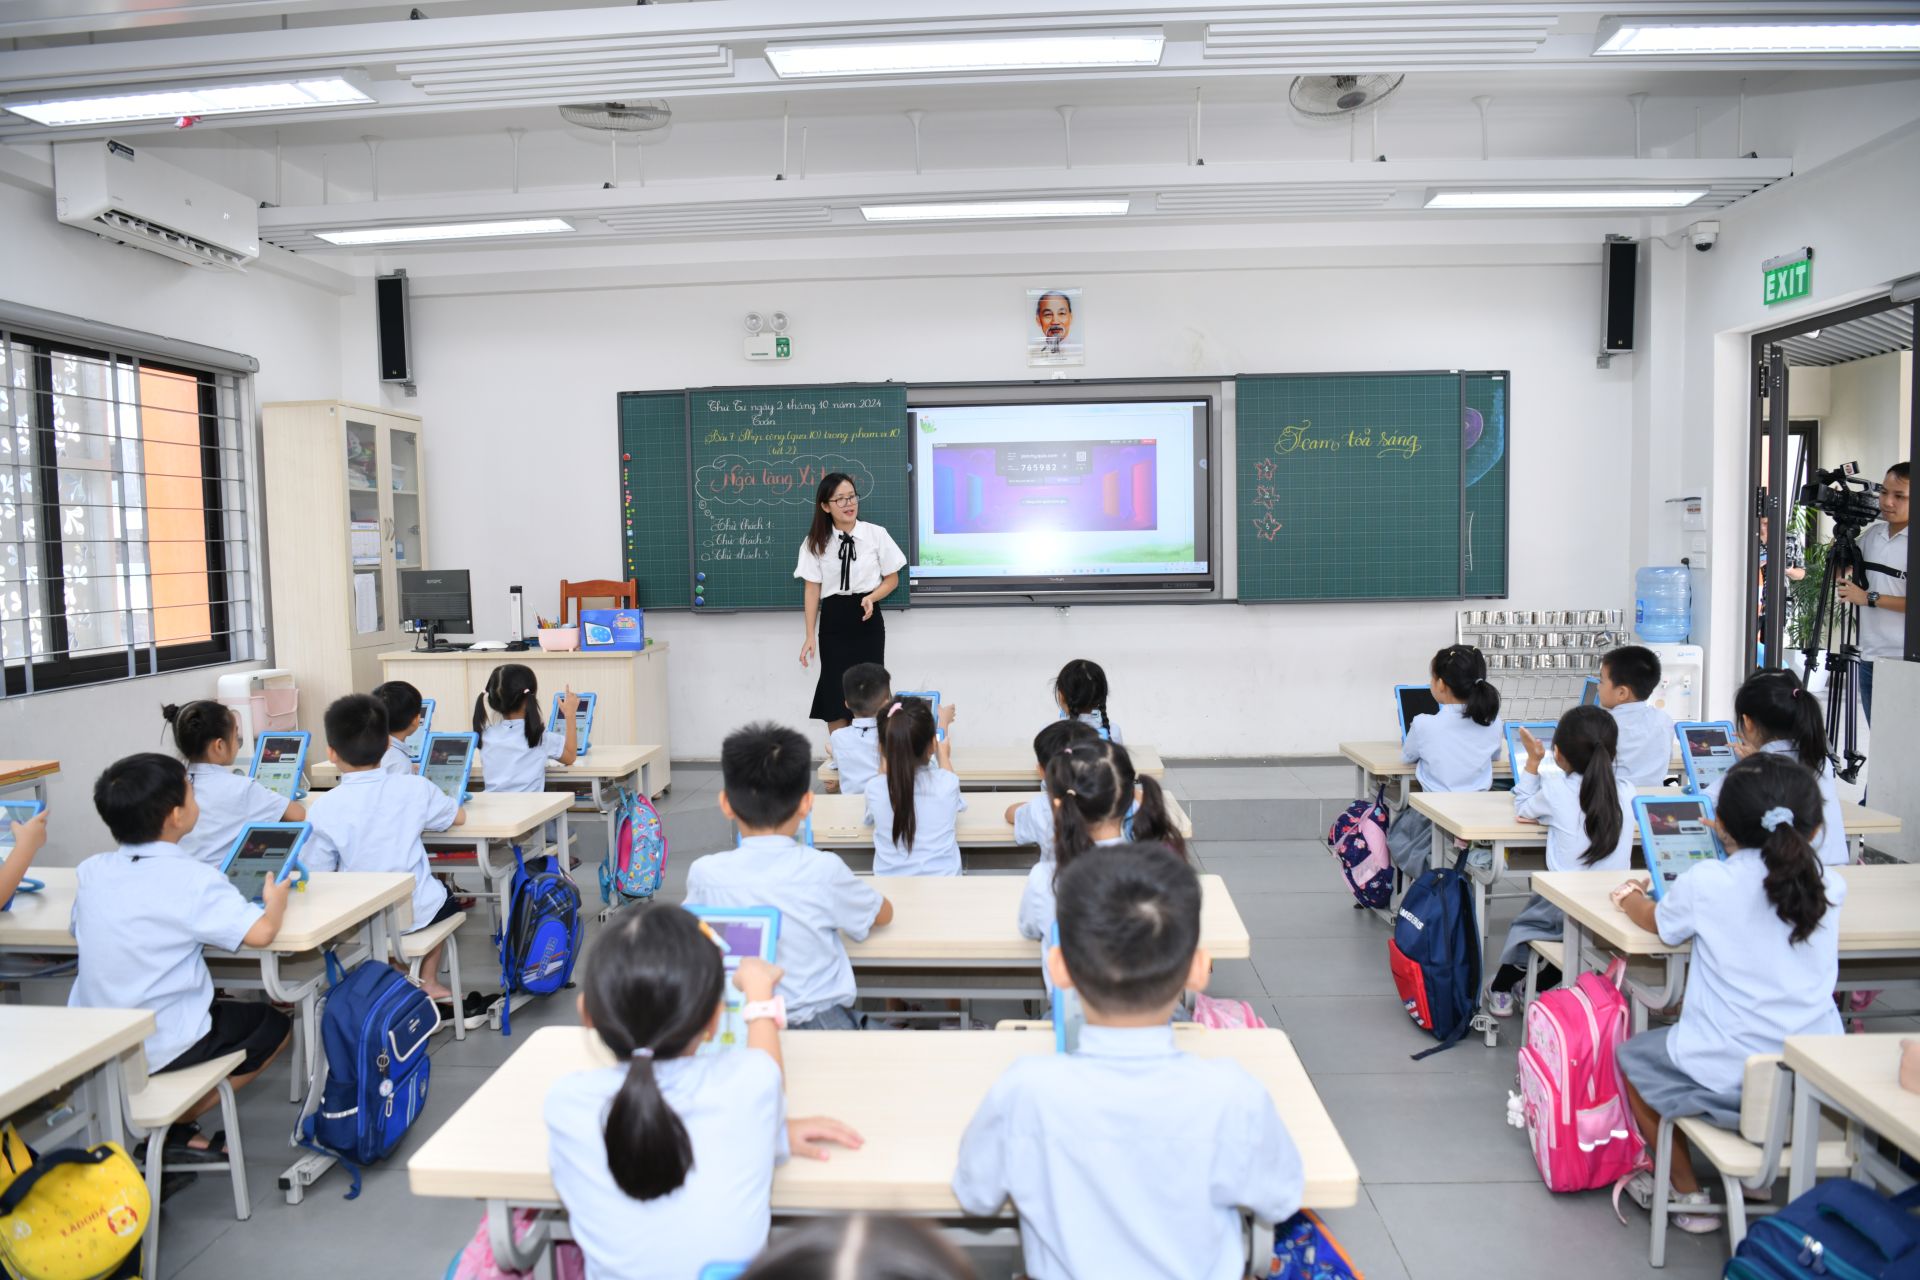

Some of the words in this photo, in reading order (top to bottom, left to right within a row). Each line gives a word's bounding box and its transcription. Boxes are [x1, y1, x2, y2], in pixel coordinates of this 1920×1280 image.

[1766, 264, 1807, 302] EXIT
[776, 400, 784, 410] 2
[819, 399, 830, 409] 10
[858, 398, 882, 409] 2024
[762, 467, 794, 495] làng
